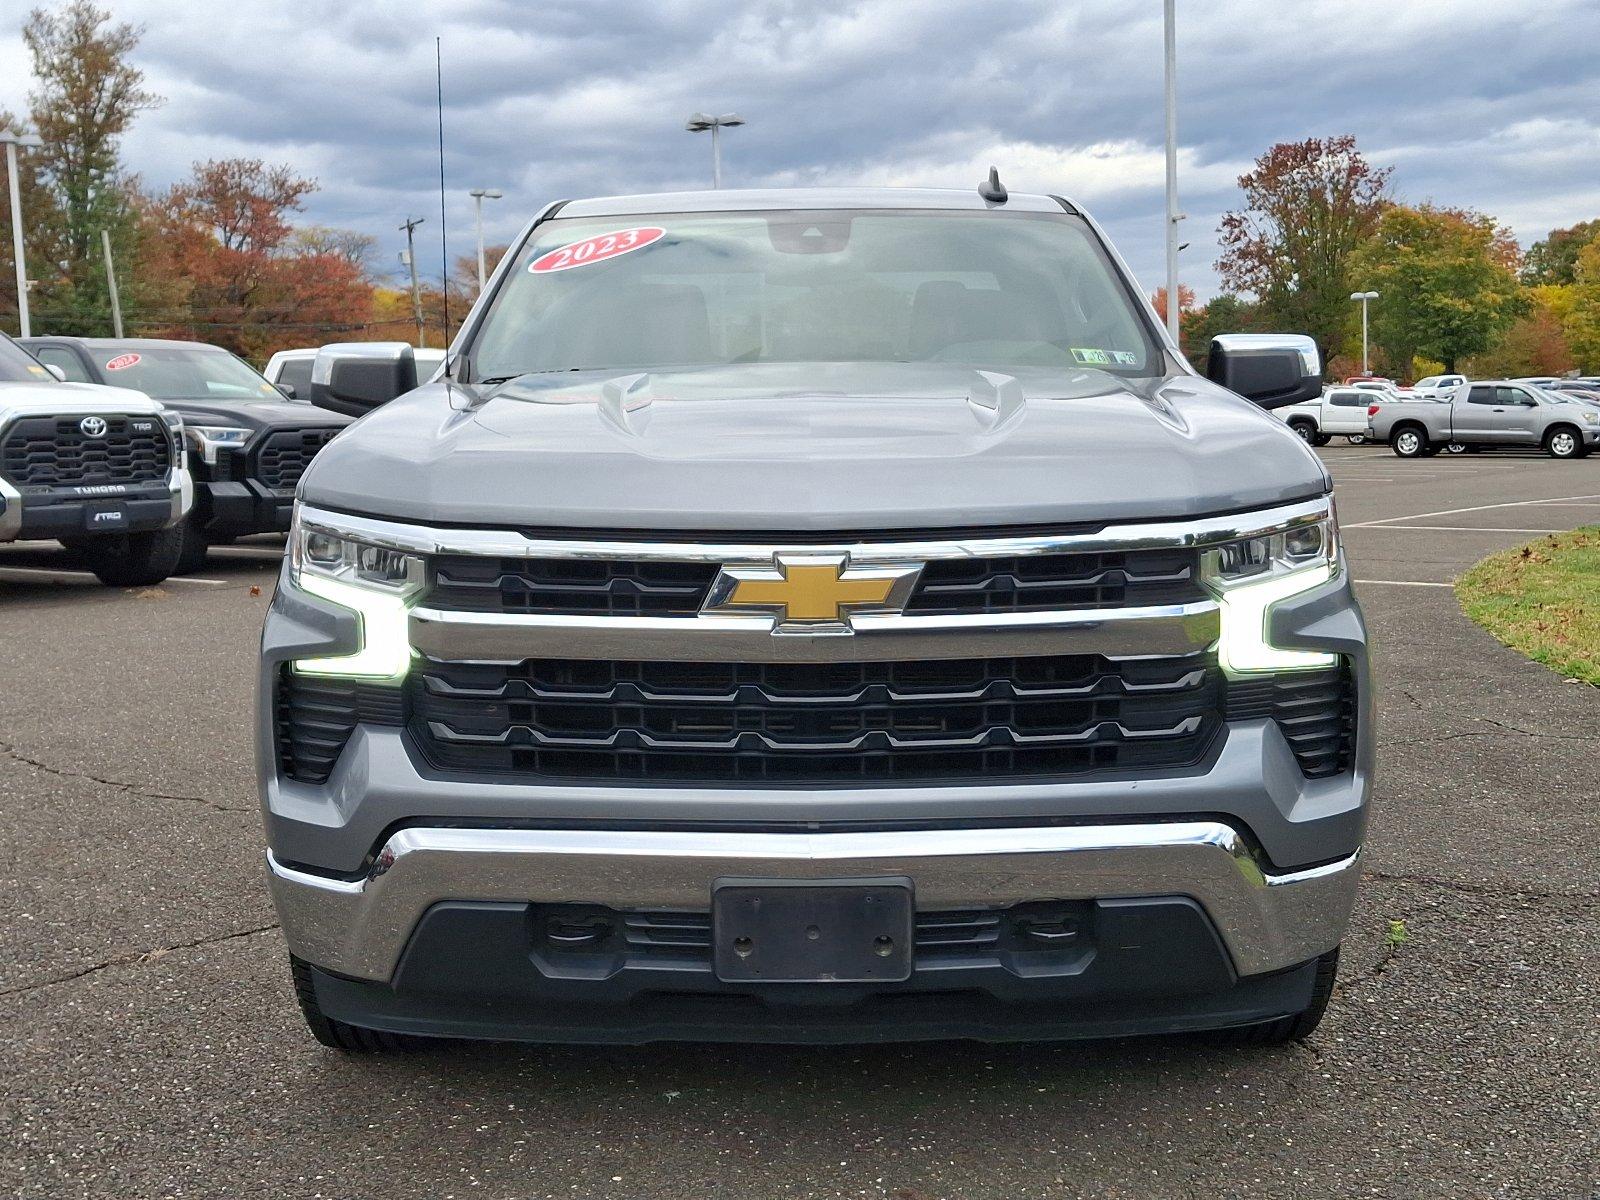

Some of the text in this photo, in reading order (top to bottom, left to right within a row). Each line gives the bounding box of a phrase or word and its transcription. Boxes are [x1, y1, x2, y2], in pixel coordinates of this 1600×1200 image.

[550, 230, 639, 269] 2023
[132, 422, 152, 431] TRD
[73, 485, 126, 495] TUNDRA
